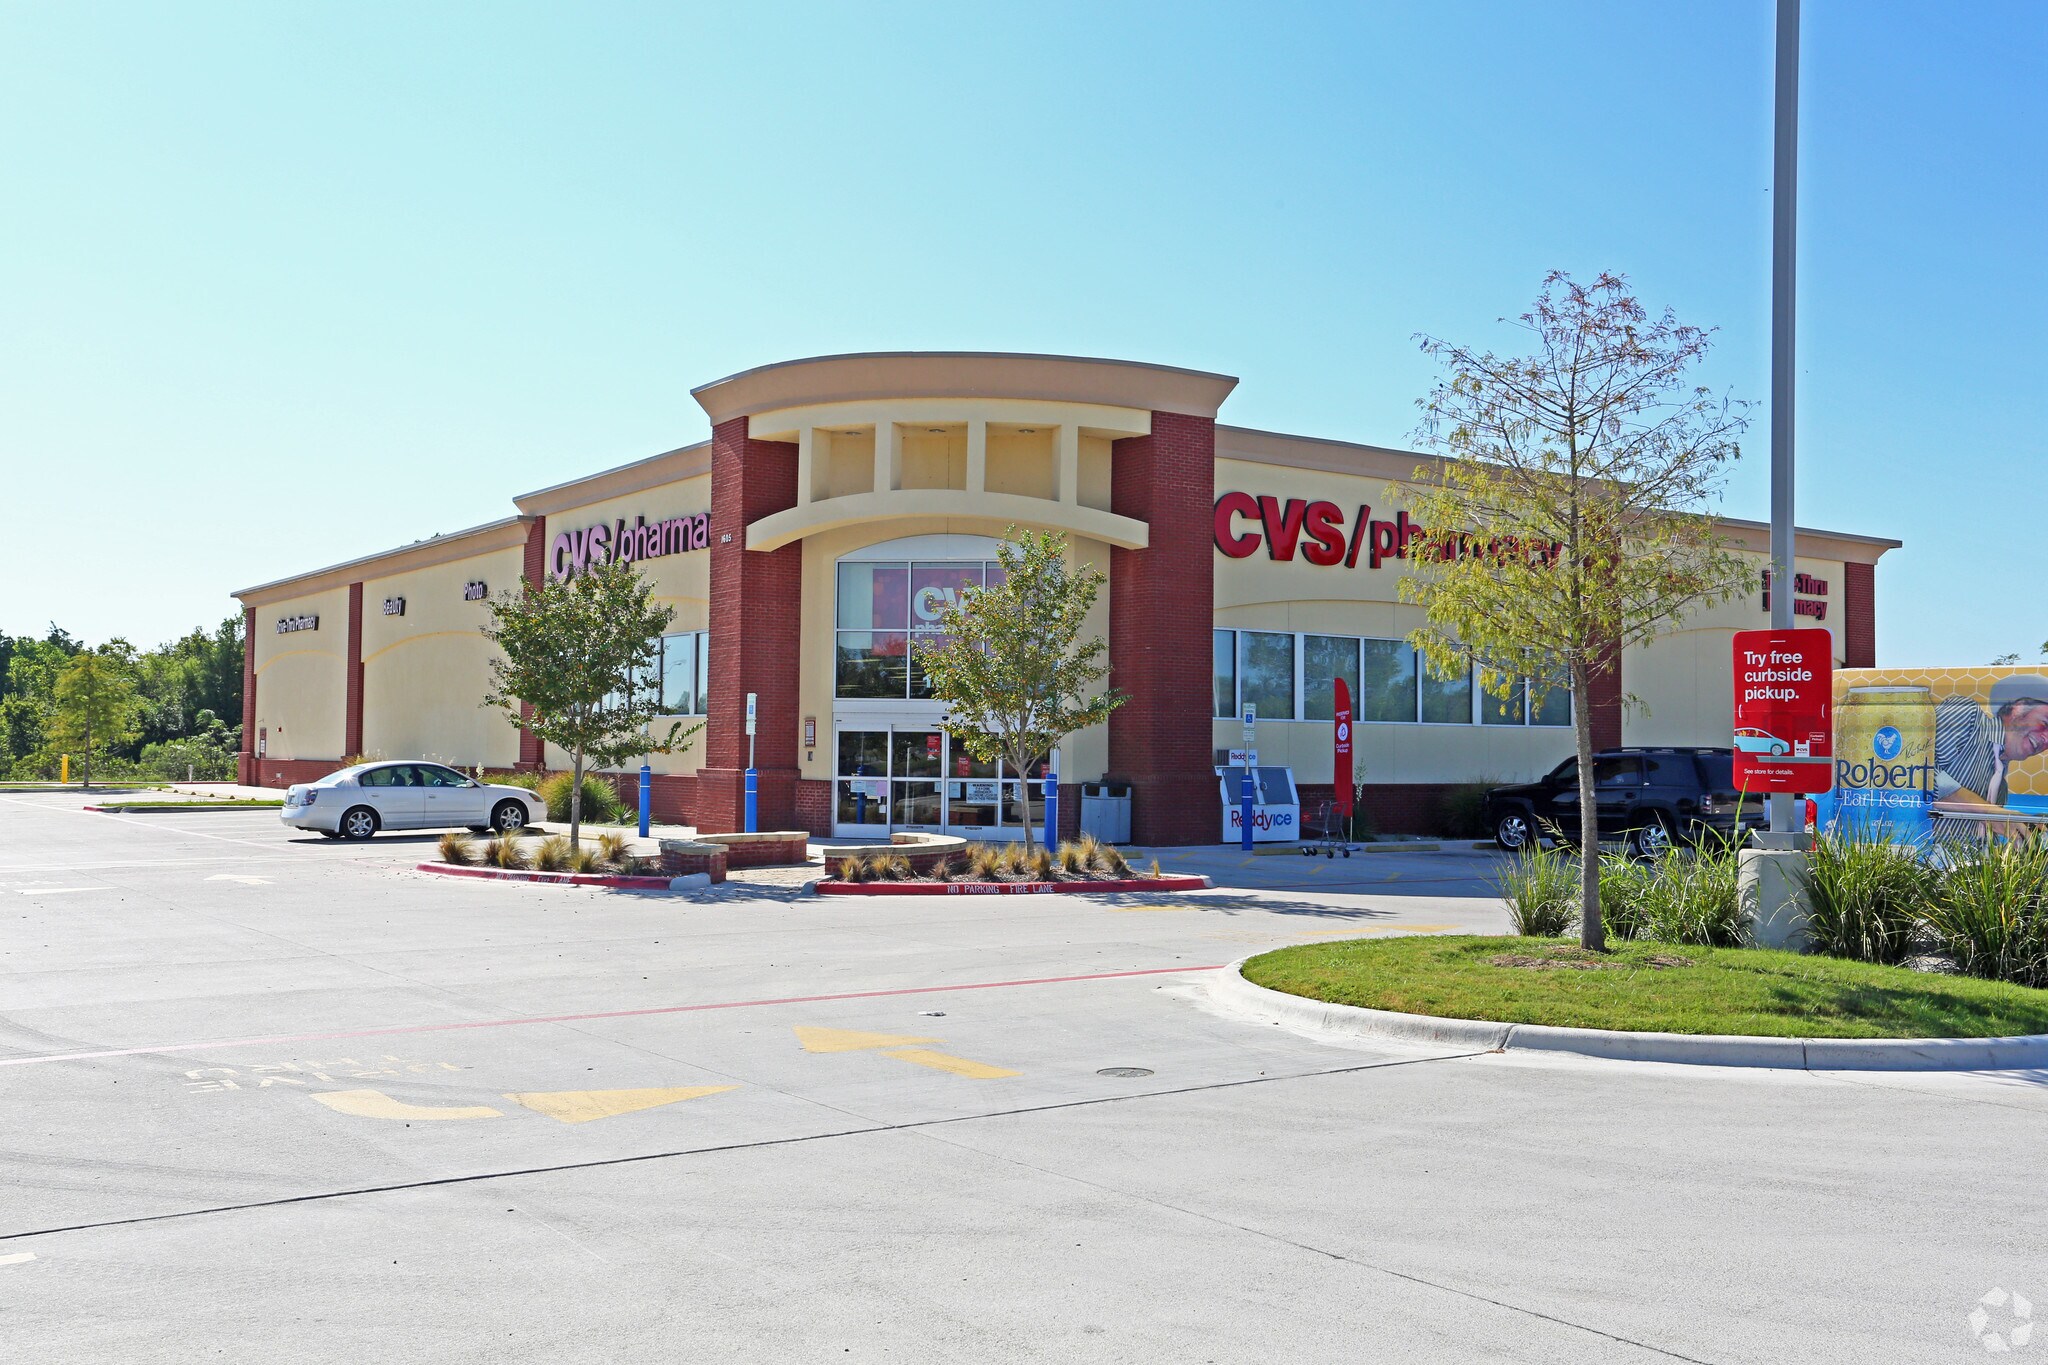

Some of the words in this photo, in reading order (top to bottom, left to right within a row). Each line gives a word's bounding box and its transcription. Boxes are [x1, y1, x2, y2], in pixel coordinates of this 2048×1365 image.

[550, 512, 711, 583] CVS/pharma
[463, 581, 486, 601] Photo
[383, 598, 405, 617] Beauty
[1743, 651, 1767, 668] Try
[1770, 650, 1803, 664] free
[1744, 667, 1812, 682] curbside
[1745, 685, 1800, 703] pickup.
[1836, 757, 1935, 804] Robert
[1843, 789, 1874, 806] Earl
[1878, 790, 1922, 809] Keen
[947, 885, 960, 894] NO
[964, 885, 1000, 894] PARKING
[1009, 884, 1029, 894] FIRE
[1033, 884, 1055, 893] LANE
